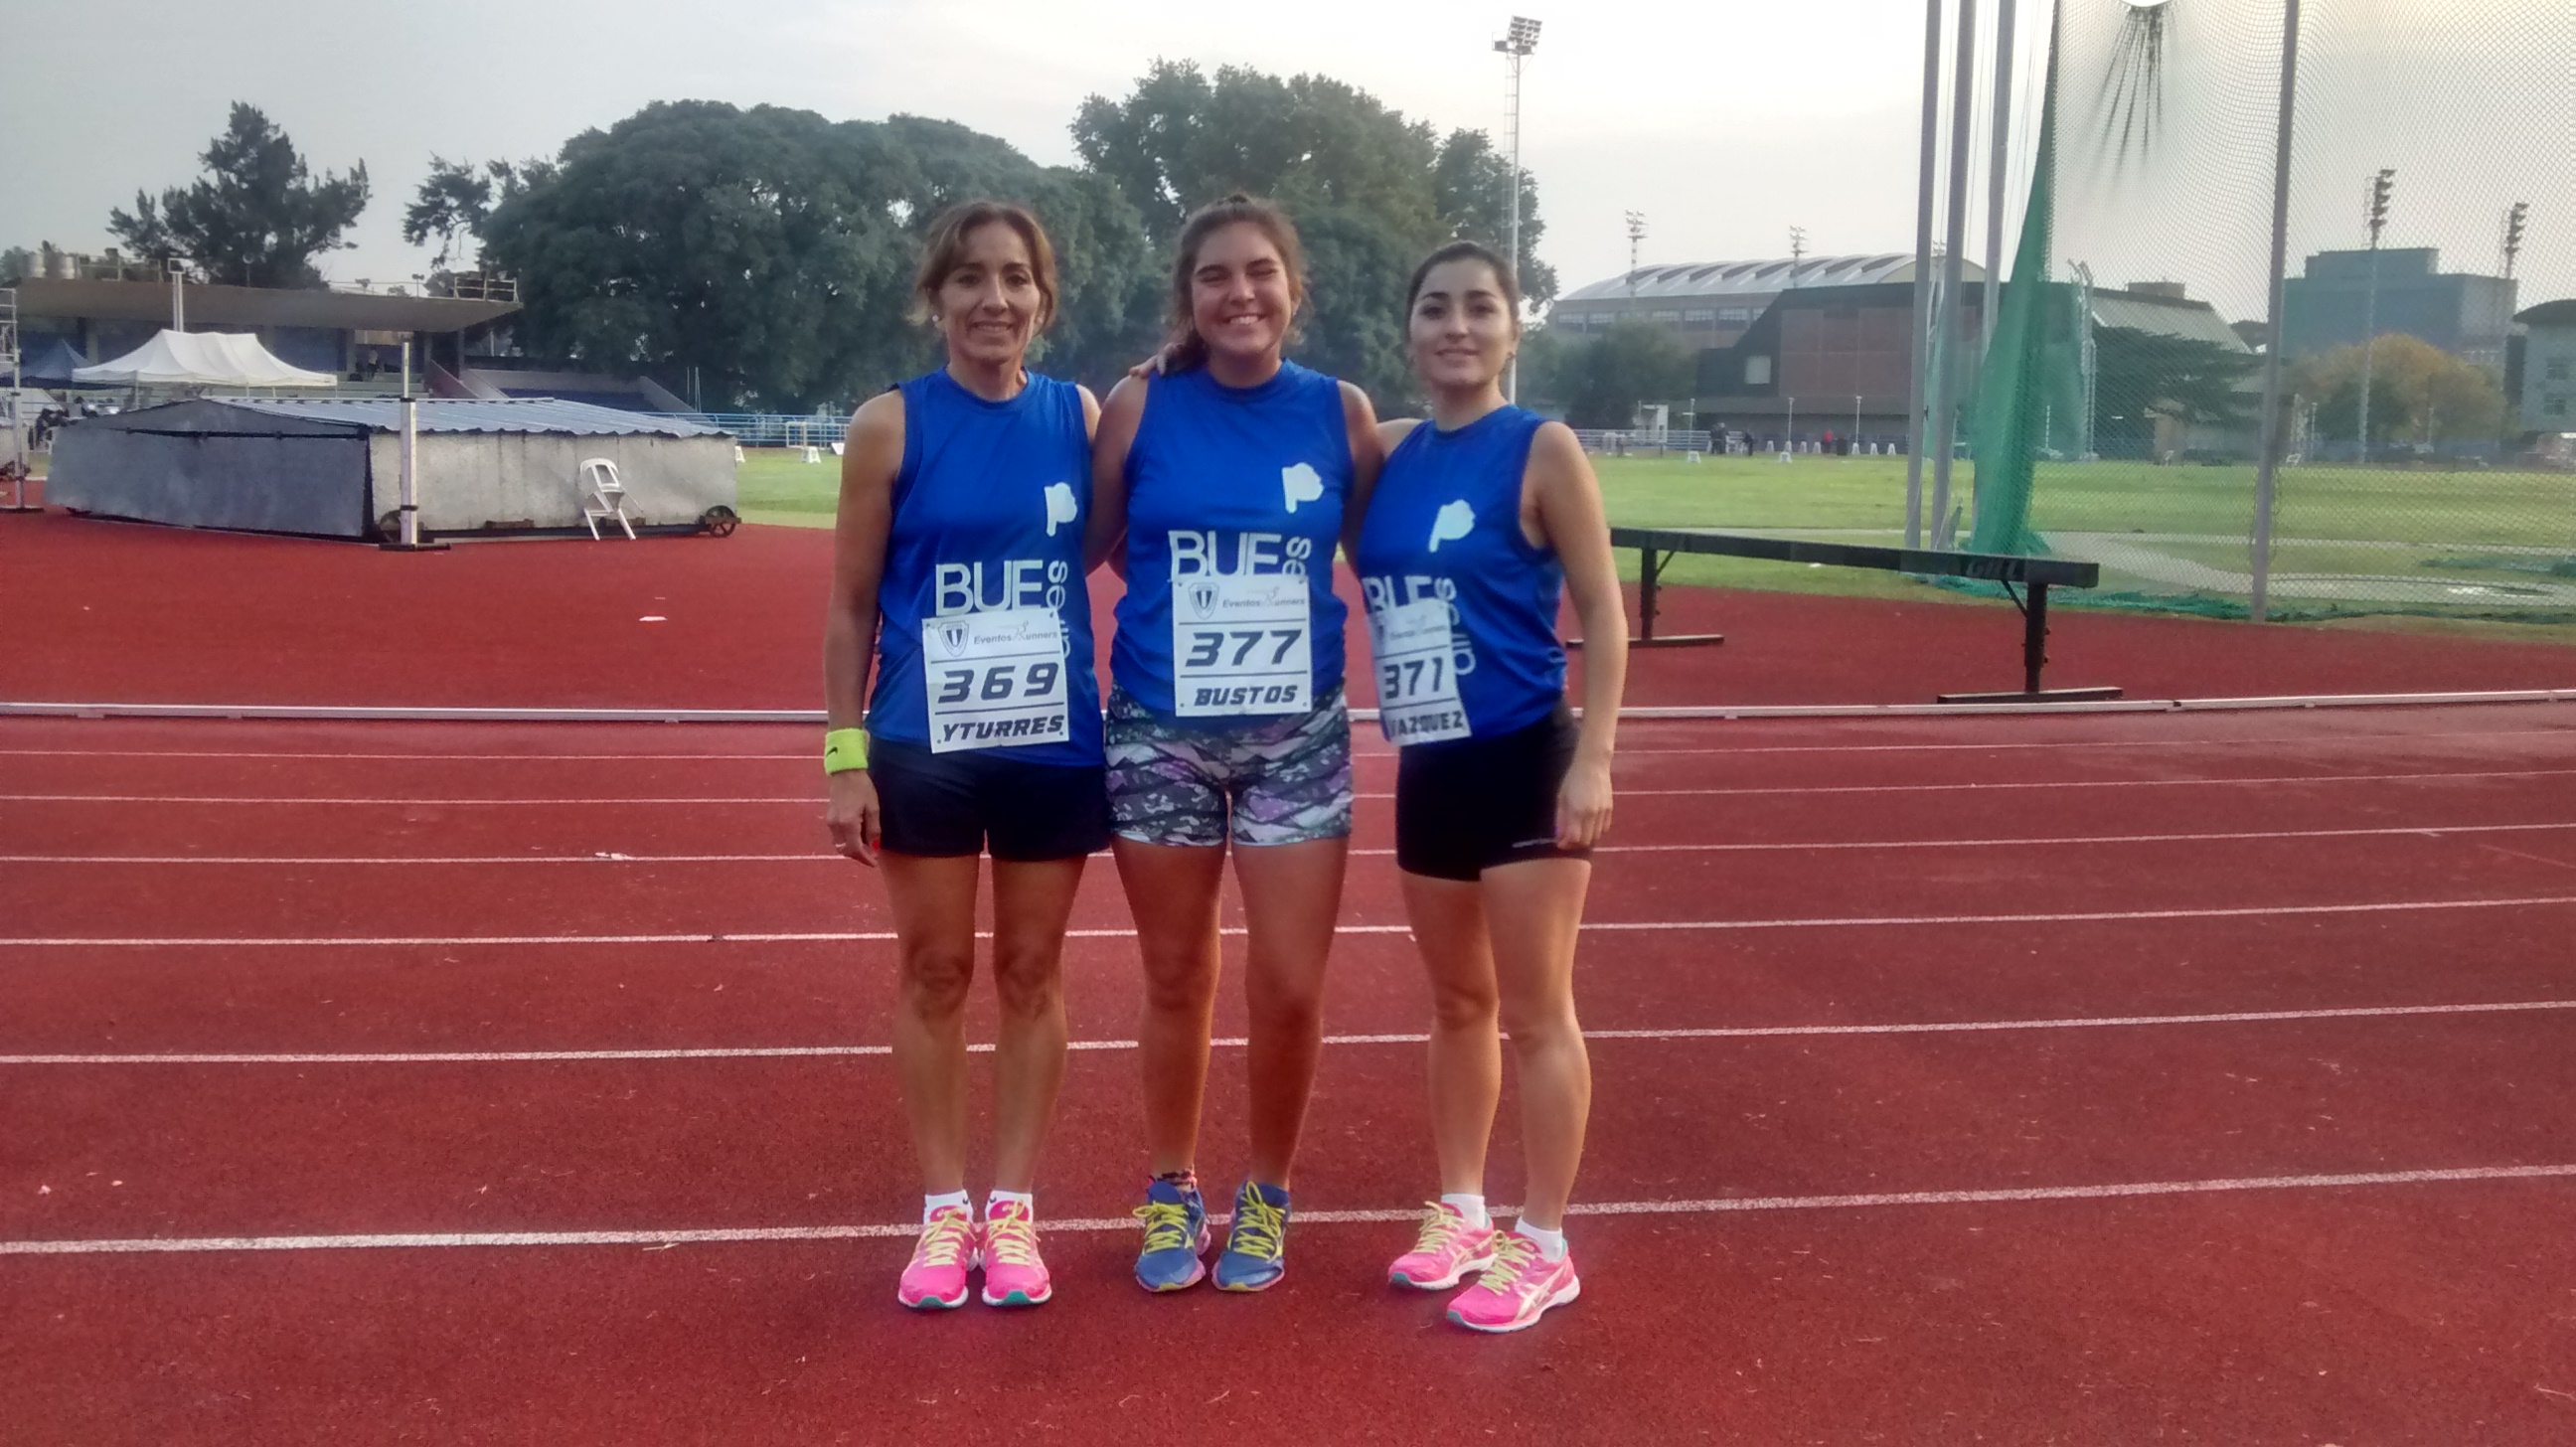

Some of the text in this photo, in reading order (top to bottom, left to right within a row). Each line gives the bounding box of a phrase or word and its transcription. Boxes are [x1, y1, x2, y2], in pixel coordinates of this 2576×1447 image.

[1168, 530, 1282, 575] BUE
[935, 560, 1043, 616] BUE
[974, 634, 1012, 645] Eventos
[1185, 629, 1302, 668] 377
[937, 662, 1059, 704] 369
[1194, 685, 1298, 707] BUSTOS
[1383, 657, 1444, 700] 371
[942, 715, 1064, 742] YTURRES
